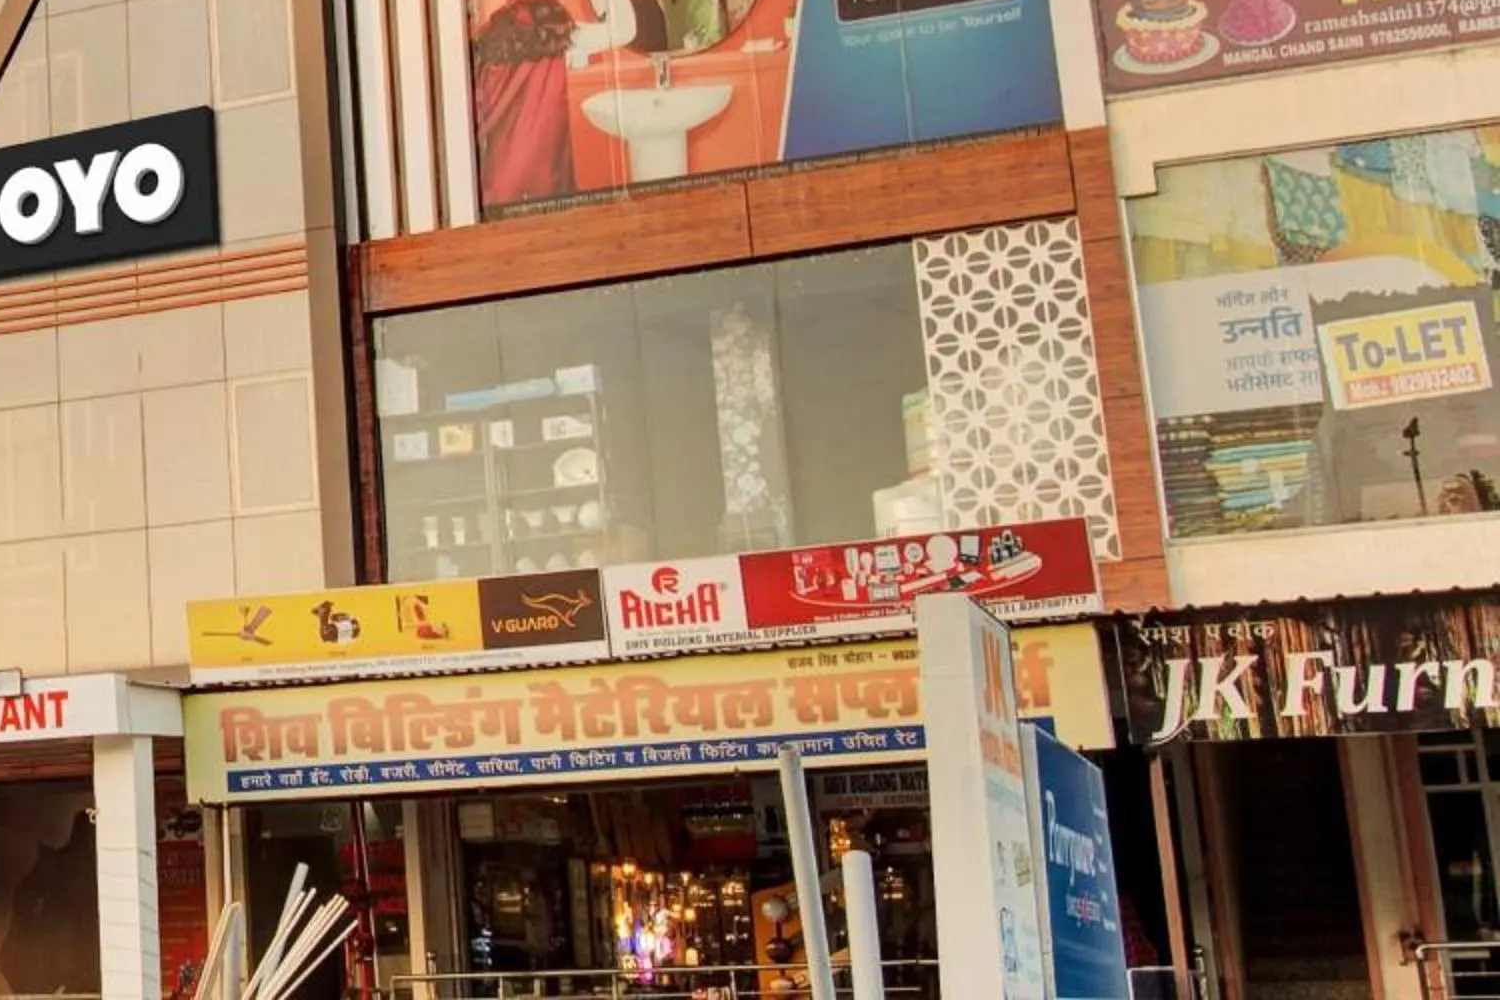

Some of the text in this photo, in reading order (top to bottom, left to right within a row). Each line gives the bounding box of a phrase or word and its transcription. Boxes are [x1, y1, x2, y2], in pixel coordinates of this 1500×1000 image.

[1280, 38, 1325, 58] CHAND
[1219, 305, 1303, 344] उन्नति
[1335, 316, 1466, 371] To-LET
[619, 582, 720, 629] RICHA
[653, 635, 702, 649] BUILDING
[705, 630, 760, 645] MATERIAL
[1151, 650, 1500, 747] JK Furn
[530, 752, 562, 772] पानी
[569, 748, 617, 768] फिटिंग
[641, 743, 692, 764] बिजली
[699, 740, 749, 760] फिटिंग
[893, 729, 918, 747] रेट
